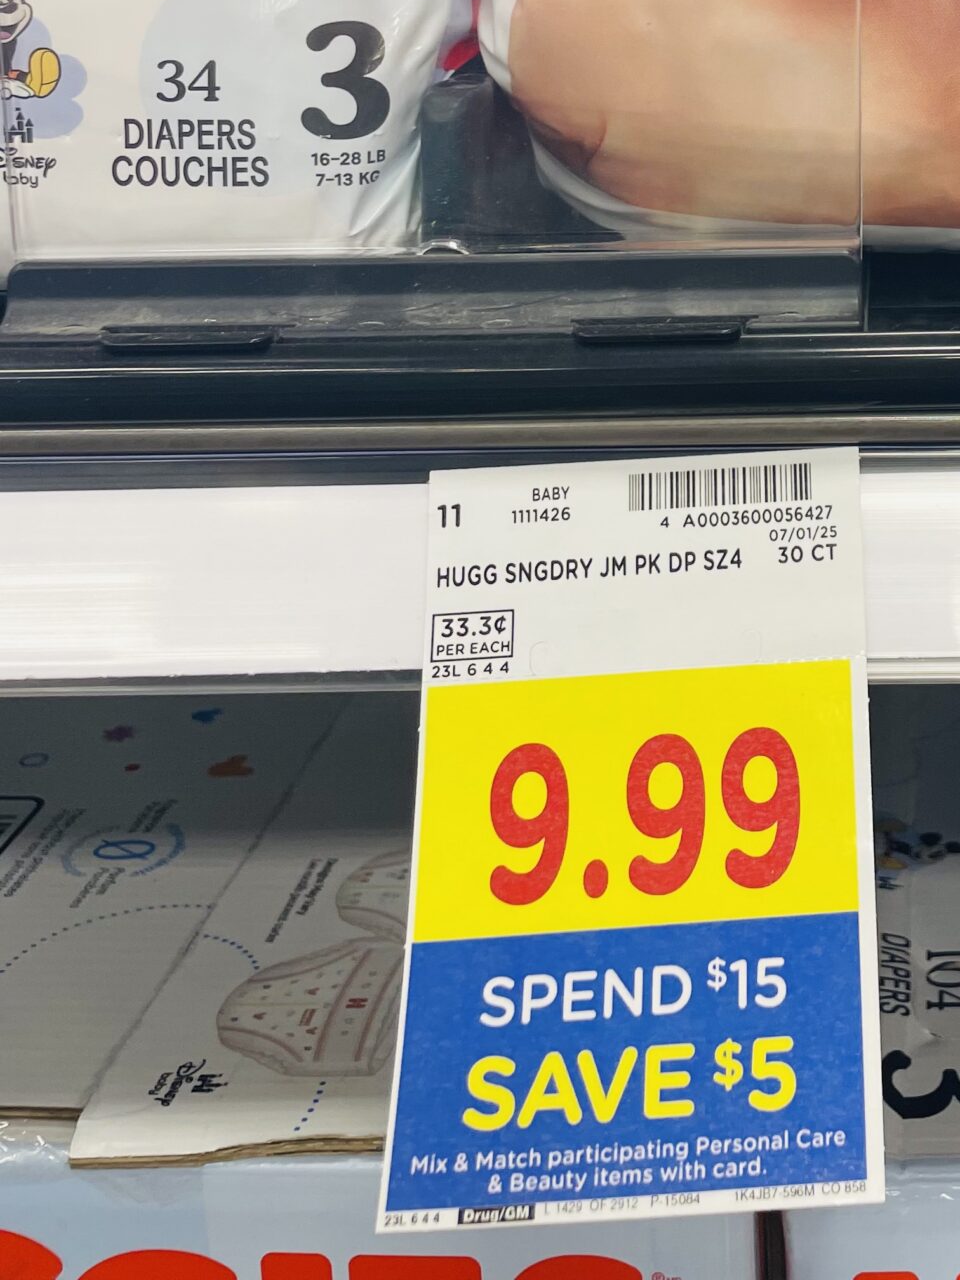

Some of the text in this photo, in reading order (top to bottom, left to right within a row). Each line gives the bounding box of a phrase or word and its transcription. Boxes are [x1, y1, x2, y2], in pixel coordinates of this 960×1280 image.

[156, 59, 221, 102] 34
[301, 20, 391, 140] 3
[123, 118, 256, 150] DIAPERS
[112, 155, 270, 187] COUCHES
[367, 149, 386, 164] LB
[532, 486, 570, 502] BABY
[437, 503, 461, 528] 11
[511, 507, 570, 525] 1111426
[660, 504, 833, 528] 4 A0003600056427
[769, 526, 837, 543] 07/01/25
[436, 548, 742, 588] HUGG SNGDRY JM PK DP SZ4
[778, 544, 837, 564] 30 CT
[441, 616, 507, 638] 33.3¢
[436, 640, 510, 656] PER EACH
[432, 663, 477, 679] 23L 6
[489, 726, 800, 906] 9.99
[880, 933, 911, 1016] DIAPERS
[479, 956, 787, 1028] SPEND $15
[462, 1036, 797, 1132] SAVE $5
[411, 1128, 846, 1175] Mix & Match participating Personal Care
[487, 1156, 768, 1194] & Beauty items with card.
